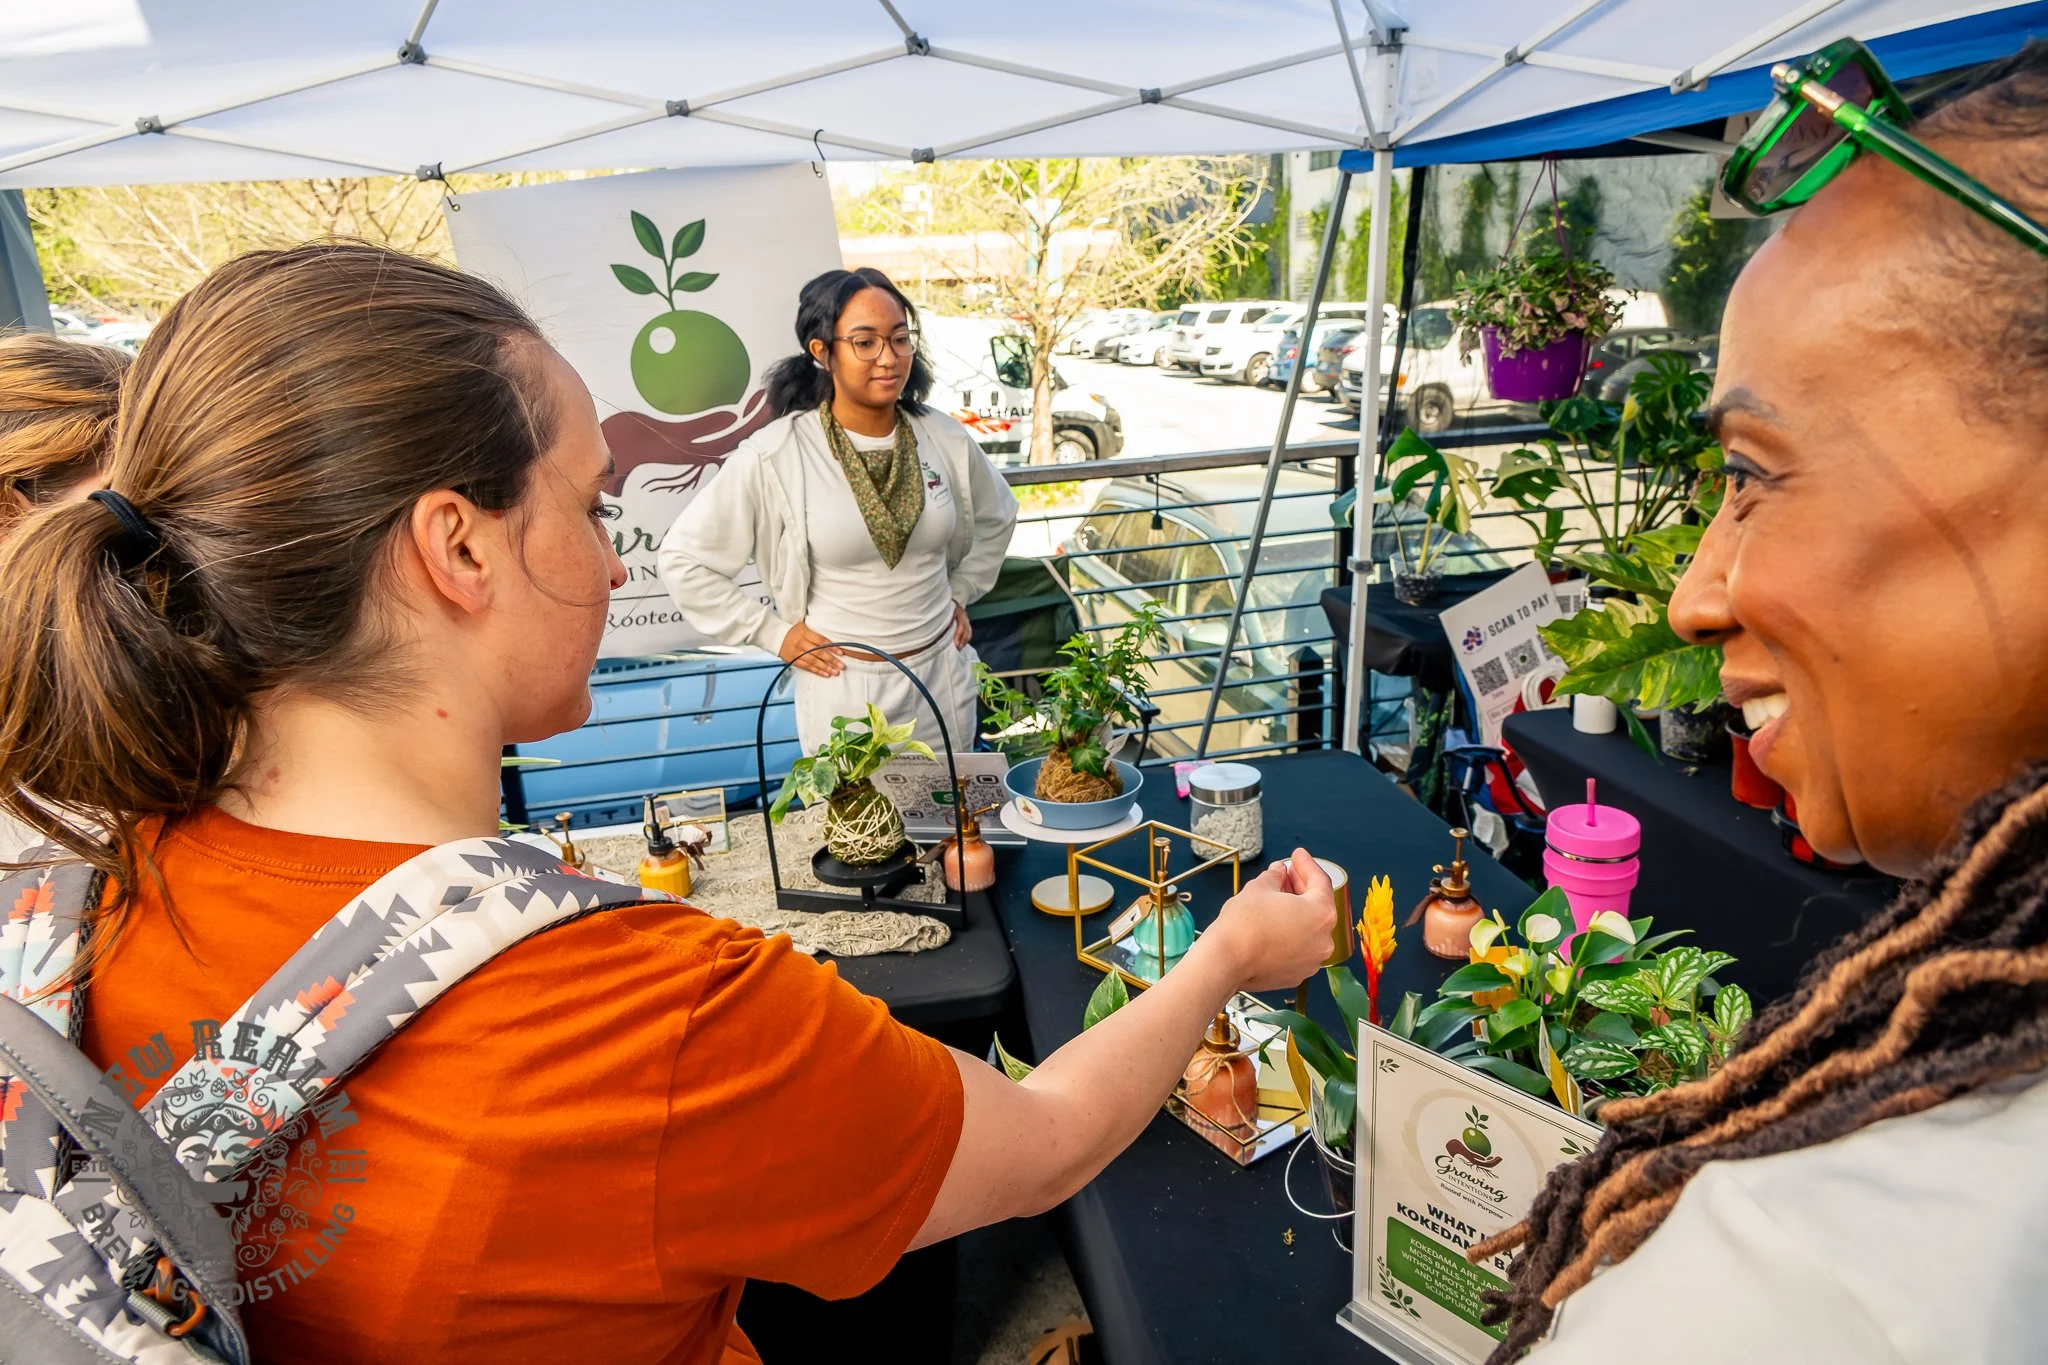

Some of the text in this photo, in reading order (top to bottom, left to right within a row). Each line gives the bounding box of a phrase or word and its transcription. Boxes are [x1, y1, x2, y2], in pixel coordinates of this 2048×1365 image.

[1488, 593, 1549, 637] SCAN TO PAY
[1434, 1154, 1509, 1203] Growing
[1448, 1174, 1493, 1201] INTENTIONS
[1427, 1202, 1477, 1238] WHAT
[1440, 1182, 1504, 1220] Rooted with Purpose
[1396, 1202, 1489, 1263] KOKEDAM
[1401, 1250, 1440, 1278] WITHOUT
[1409, 1246, 1433, 1265] MOSS
[1410, 1238, 1458, 1271] KOKEDAMA
[1460, 1267, 1479, 1282] ARE
[1414, 1268, 1433, 1282] AND
[1434, 1279, 1459, 1298] MOSS
[1460, 1294, 1479, 1310] FOR
[1424, 1282, 1478, 1318] SCULPTURAL
